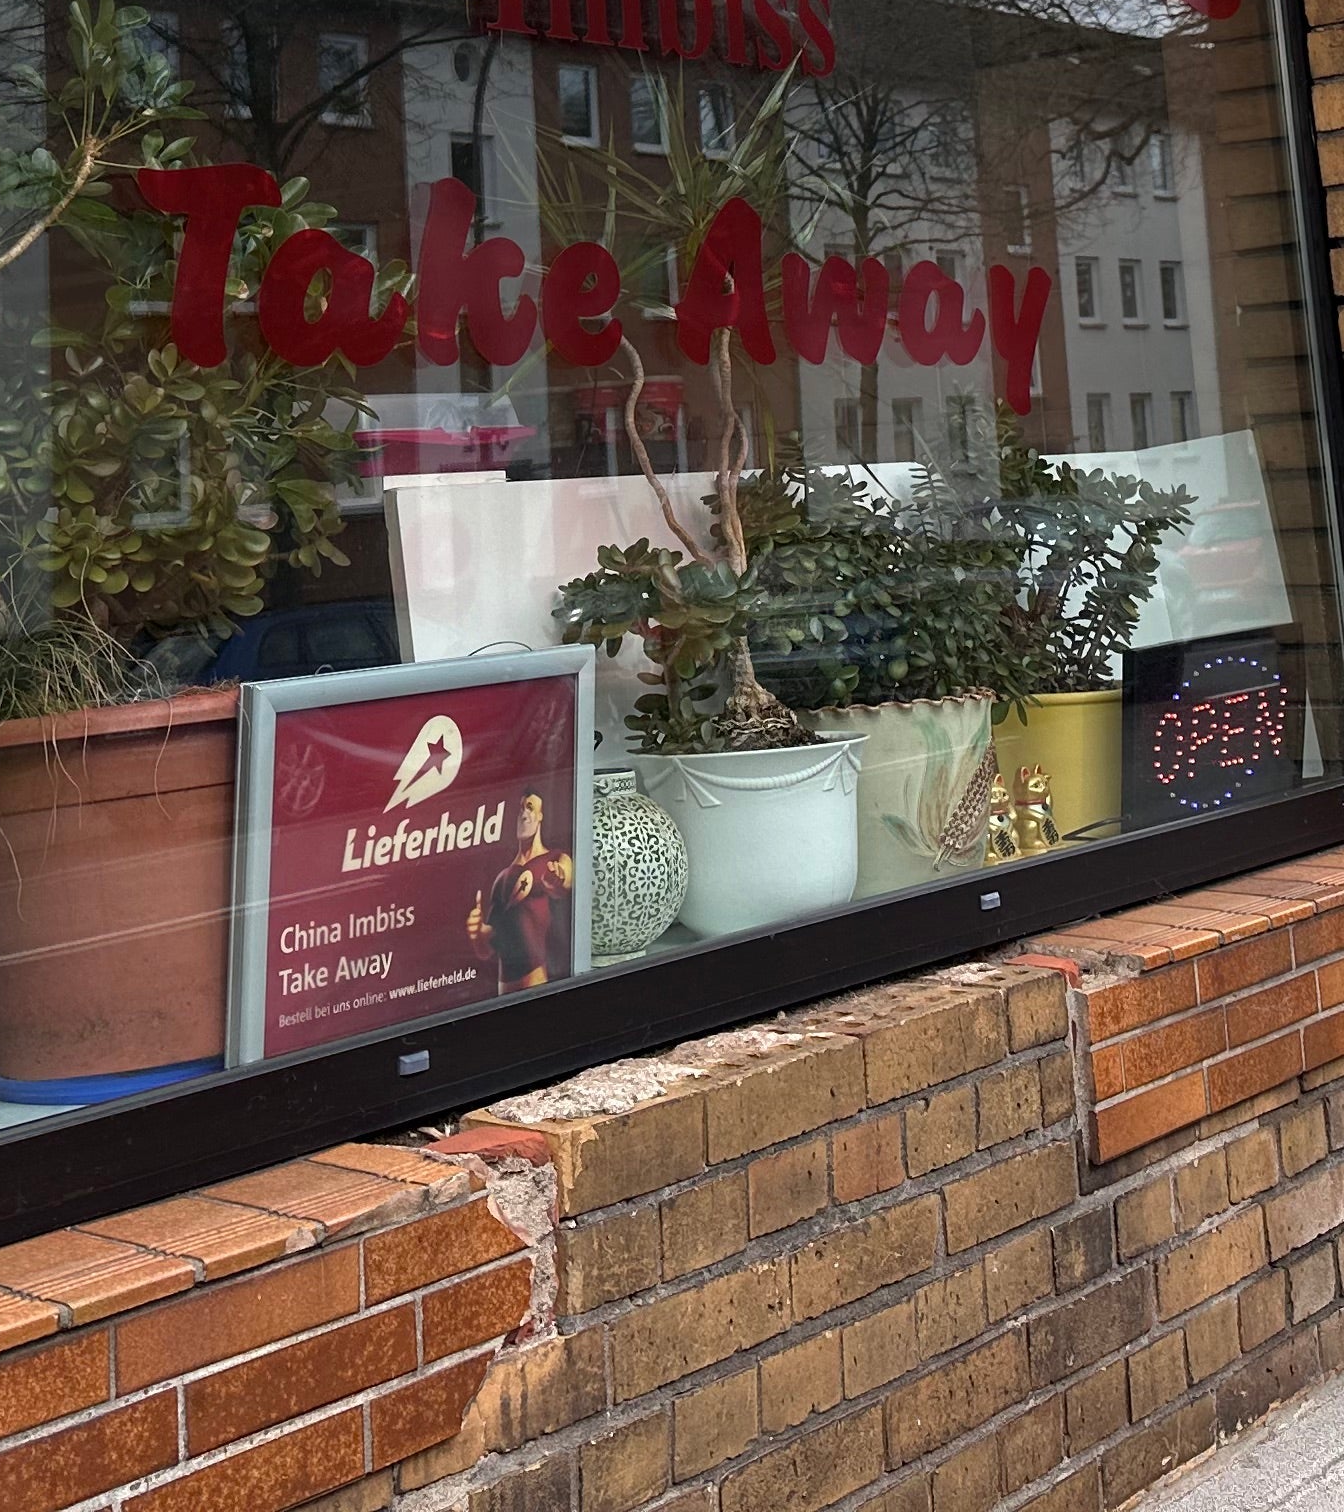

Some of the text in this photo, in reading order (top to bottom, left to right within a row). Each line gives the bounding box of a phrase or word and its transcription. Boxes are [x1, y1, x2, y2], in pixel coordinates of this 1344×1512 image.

[136, 162, 1052, 417] Take Away
[1154, 687, 1288, 785] OPEN
[341, 801, 506, 873] Lieferheld
[280, 903, 416, 955] China Imbiss
[278, 951, 393, 996] Take Away
[278, 966, 477, 1028] Bestell bei uns online: www.lieferheld.de
